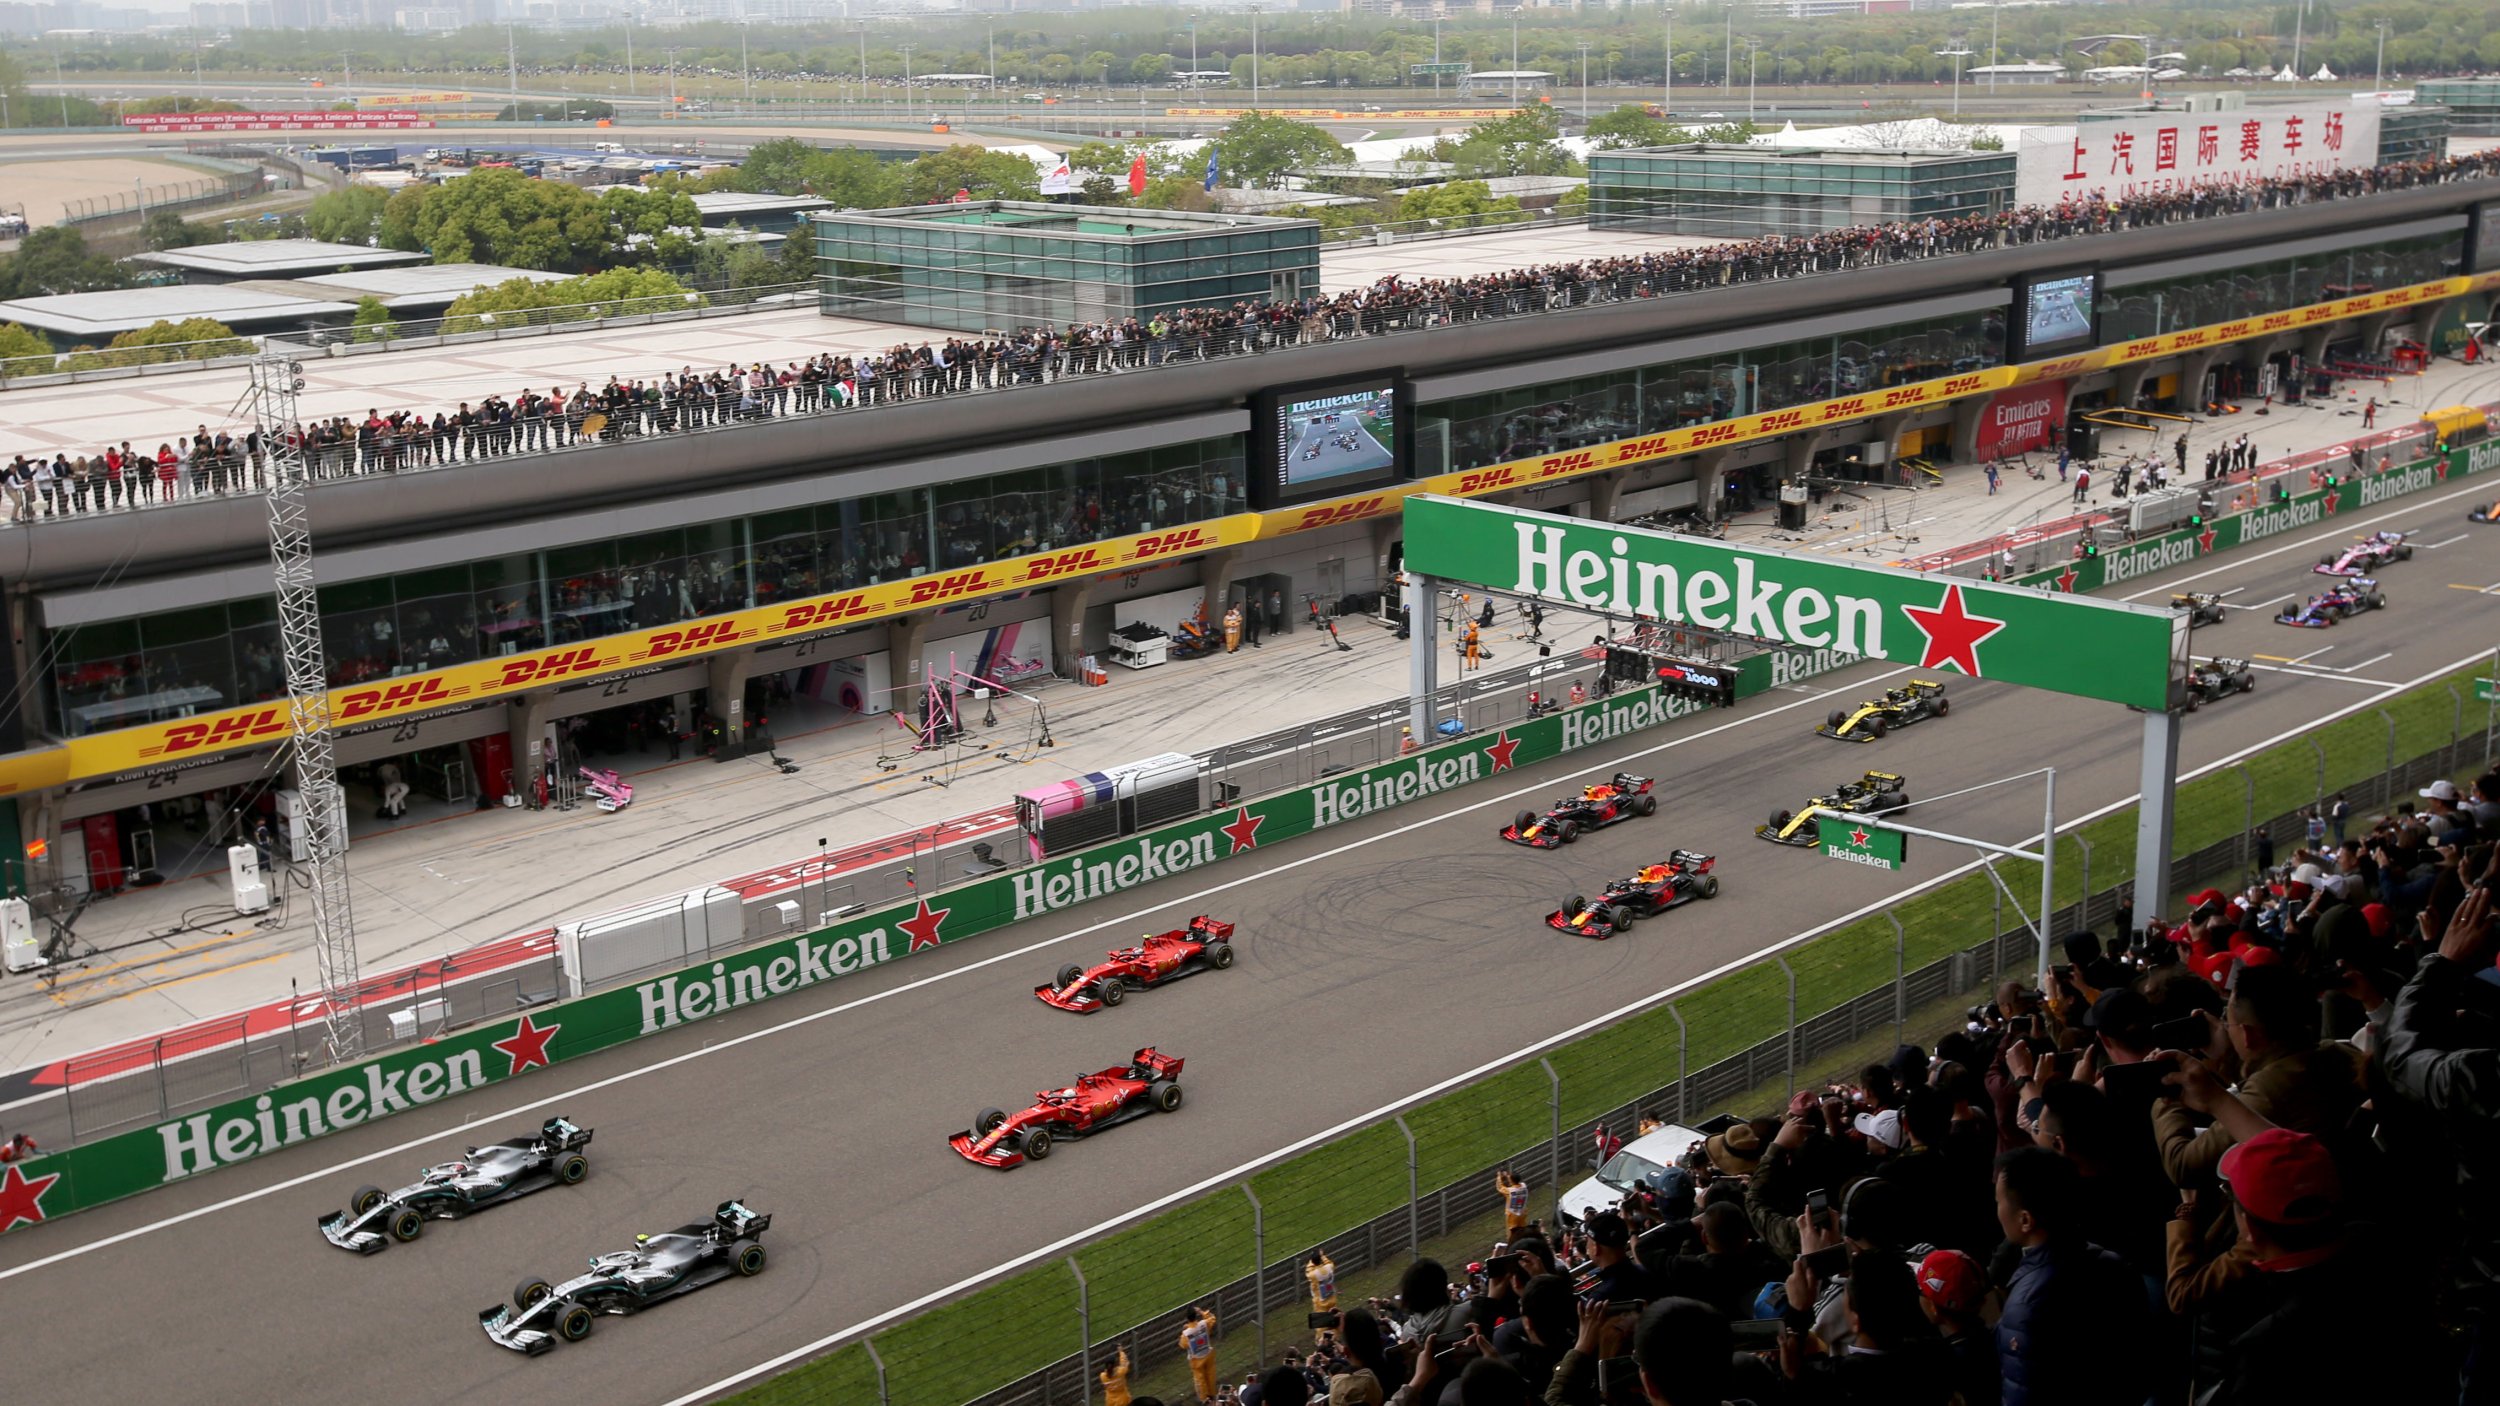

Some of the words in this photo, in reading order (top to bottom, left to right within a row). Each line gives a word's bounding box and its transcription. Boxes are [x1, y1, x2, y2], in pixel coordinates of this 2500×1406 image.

[2063, 111, 2343, 180] 上汽国际赛车场
[2062, 185, 2105, 201] SAC
[2385, 291, 2410, 305] DHL
[2423, 284, 2446, 297] DHL
[2306, 307, 2332, 321] DHL
[2345, 299, 2371, 313] DHL
[2220, 323, 2248, 339] DHL
[2263, 315, 2290, 330] DHL
[2127, 341, 2159, 358] DHL
[2175, 332, 2204, 348] DHL
[2036, 358, 2085, 380] DHL
[1944, 376, 1981, 395] DHL
[1825, 401, 1864, 419] DHL
[1886, 390, 1923, 406] DHL
[1761, 412, 1802, 432] DHL
[1996, 399, 2050, 426] Emirates
[1692, 425, 1737, 446] DHL
[1619, 438, 1667, 460] DHL
[1542, 453, 1593, 476] DHL
[1461, 468, 1514, 492] DHL
[2360, 464, 2431, 506] Heineken
[1298, 497, 1384, 530] DHL
[2239, 500, 2319, 543] Heineken
[1136, 529, 1203, 558] DHL
[1028, 550, 1100, 579] DHL
[2103, 535, 2194, 585] Heineken
[911, 572, 988, 603] DHL
[1513, 521, 1888, 660] Heineken
[785, 595, 869, 628] DHL
[648, 621, 740, 657] DHL
[502, 648, 601, 685] DHL
[1685, 672, 1718, 687] 1000
[341, 678, 449, 718] DHL
[165, 710, 284, 752] DHL
[1312, 749, 1479, 829] Heineken
[1828, 845, 1891, 870] Heineken
[1011, 828, 1217, 920] Heineken
[636, 927, 891, 1034] Heineken
[157, 1049, 487, 1182] Heineken
[529, 1140, 548, 1155] 44
[702, 1226, 721, 1244] 77
